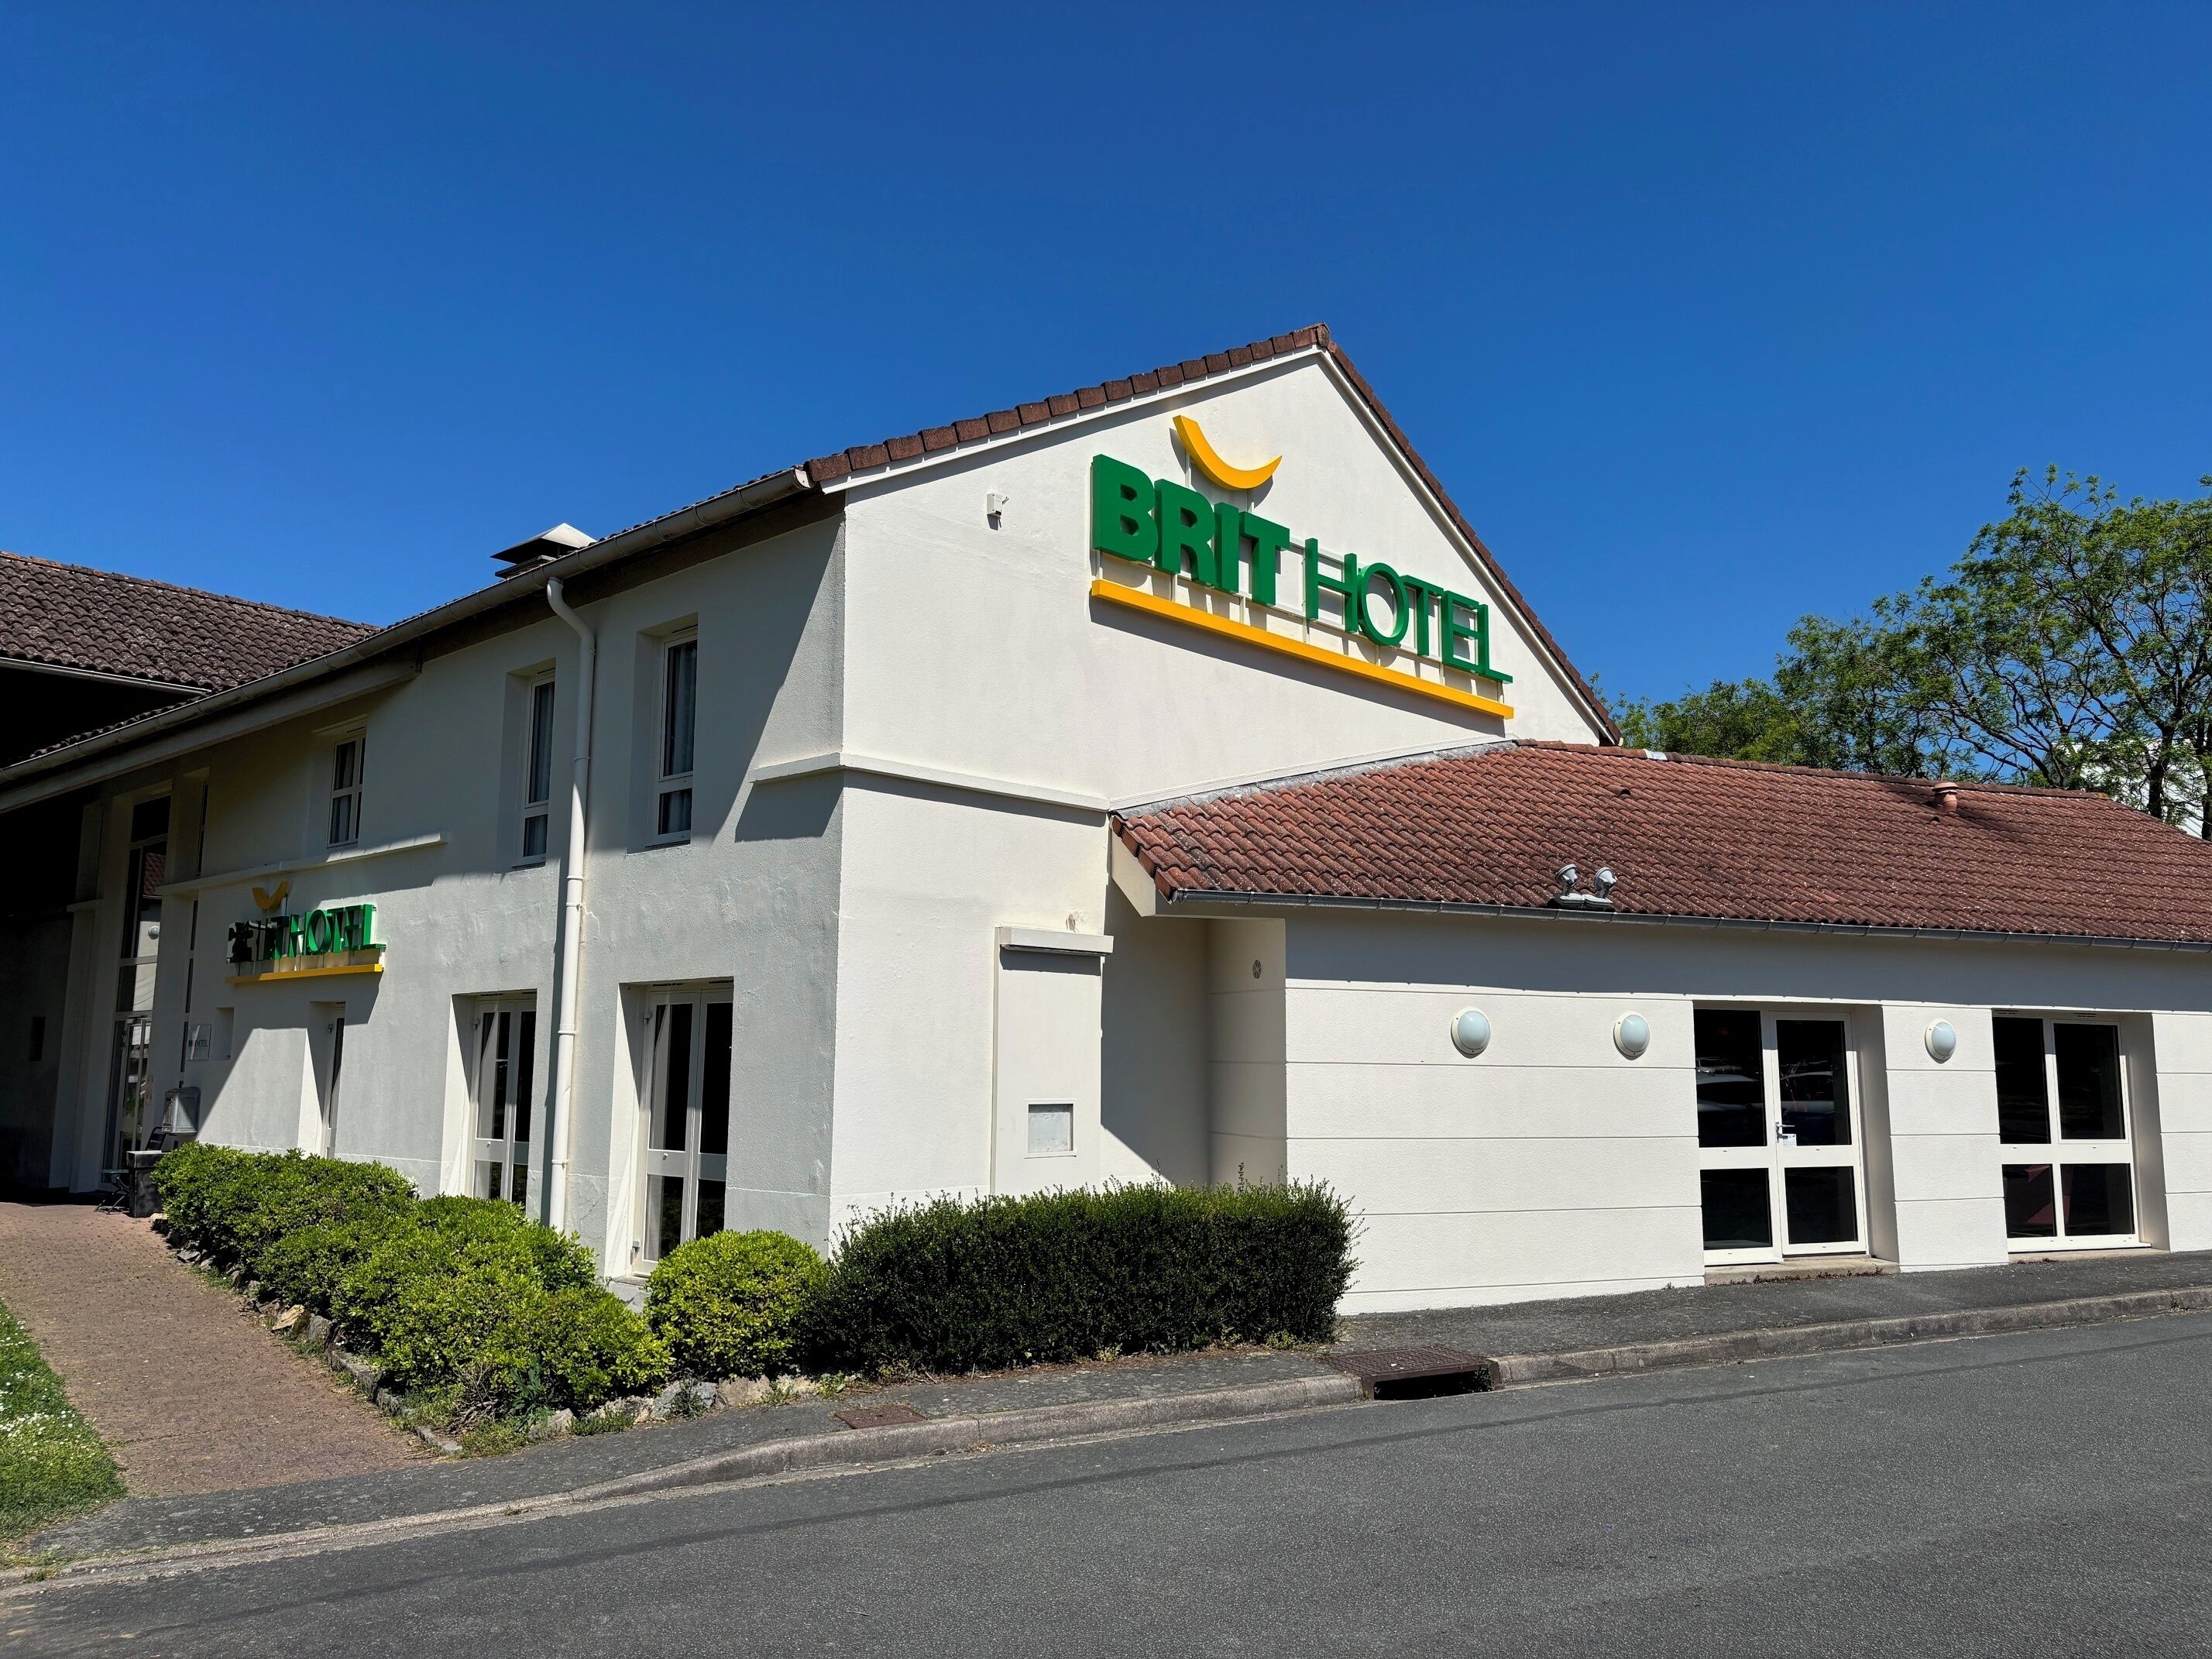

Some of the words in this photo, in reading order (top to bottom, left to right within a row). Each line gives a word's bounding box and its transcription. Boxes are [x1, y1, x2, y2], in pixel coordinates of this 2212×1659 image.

[1092, 454, 1290, 606] BRIT
[1305, 538, 1513, 683] HOTEL
[288, 904, 386, 958] HOTEL
